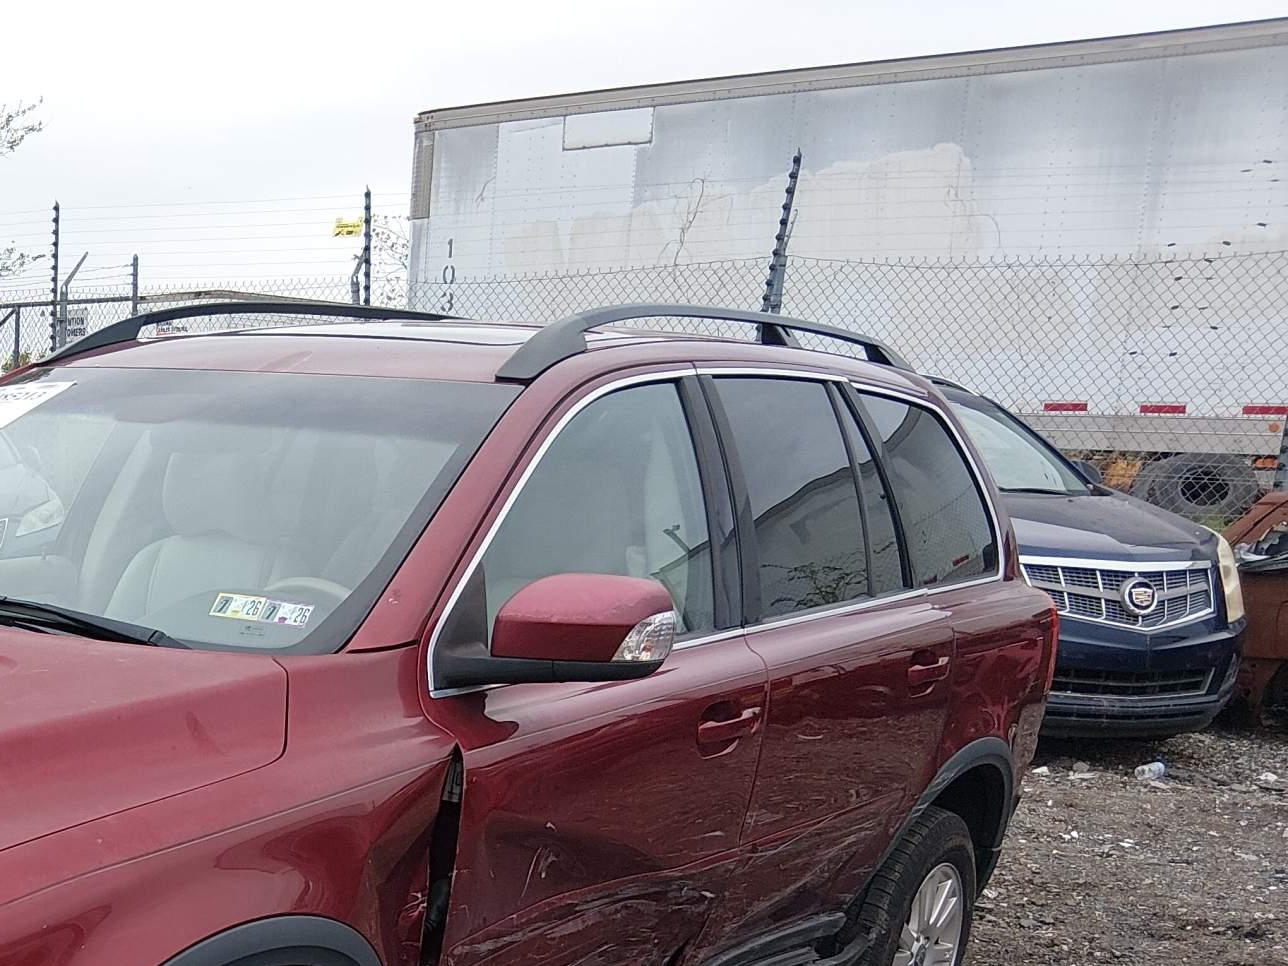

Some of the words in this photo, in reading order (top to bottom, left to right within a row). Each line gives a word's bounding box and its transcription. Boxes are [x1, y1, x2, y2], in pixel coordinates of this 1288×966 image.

[440, 238, 455, 312] 103
[245, 600, 262, 616] 26
[293, 607, 310, 624] 26
